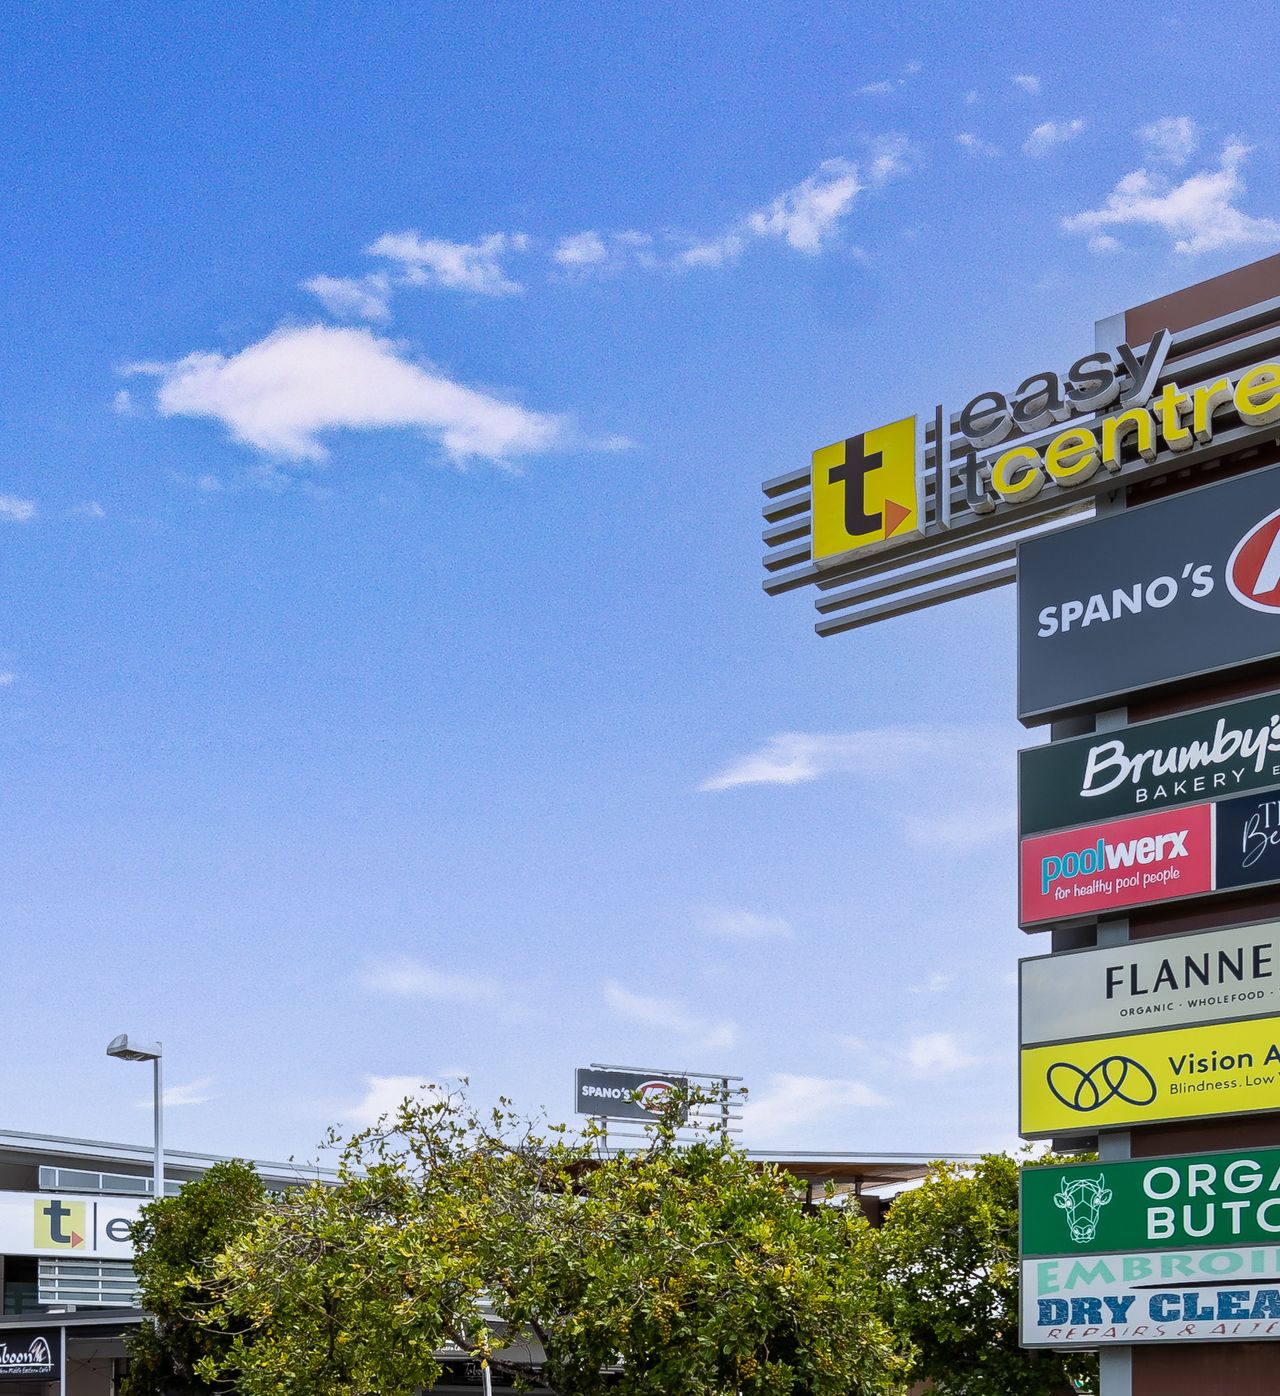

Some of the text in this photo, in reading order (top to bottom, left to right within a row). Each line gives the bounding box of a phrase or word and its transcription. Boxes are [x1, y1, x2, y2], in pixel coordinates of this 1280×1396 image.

[959, 328, 1173, 448] easy
[1037, 562, 1215, 637] SPANO'S
[1135, 768, 1246, 803] BAKERY
[1041, 829, 1189, 896] poolwerx
[1054, 867, 1181, 900] for healthy pool people
[1119, 1002, 1174, 1018] ORGANIC
[1187, 990, 1265, 1009] WHOLEFOOD
[1168, 1051, 1254, 1076] Vision
[581, 1085, 631, 1100] SPANO'S
[1170, 1077, 1243, 1095] Blindness.
[1245, 1073, 1275, 1087] Low
[1036, 1295, 1136, 1326] DRY
[1047, 1323, 1166, 1340] REPAIRS
[1177, 1322, 1196, 1336] &
